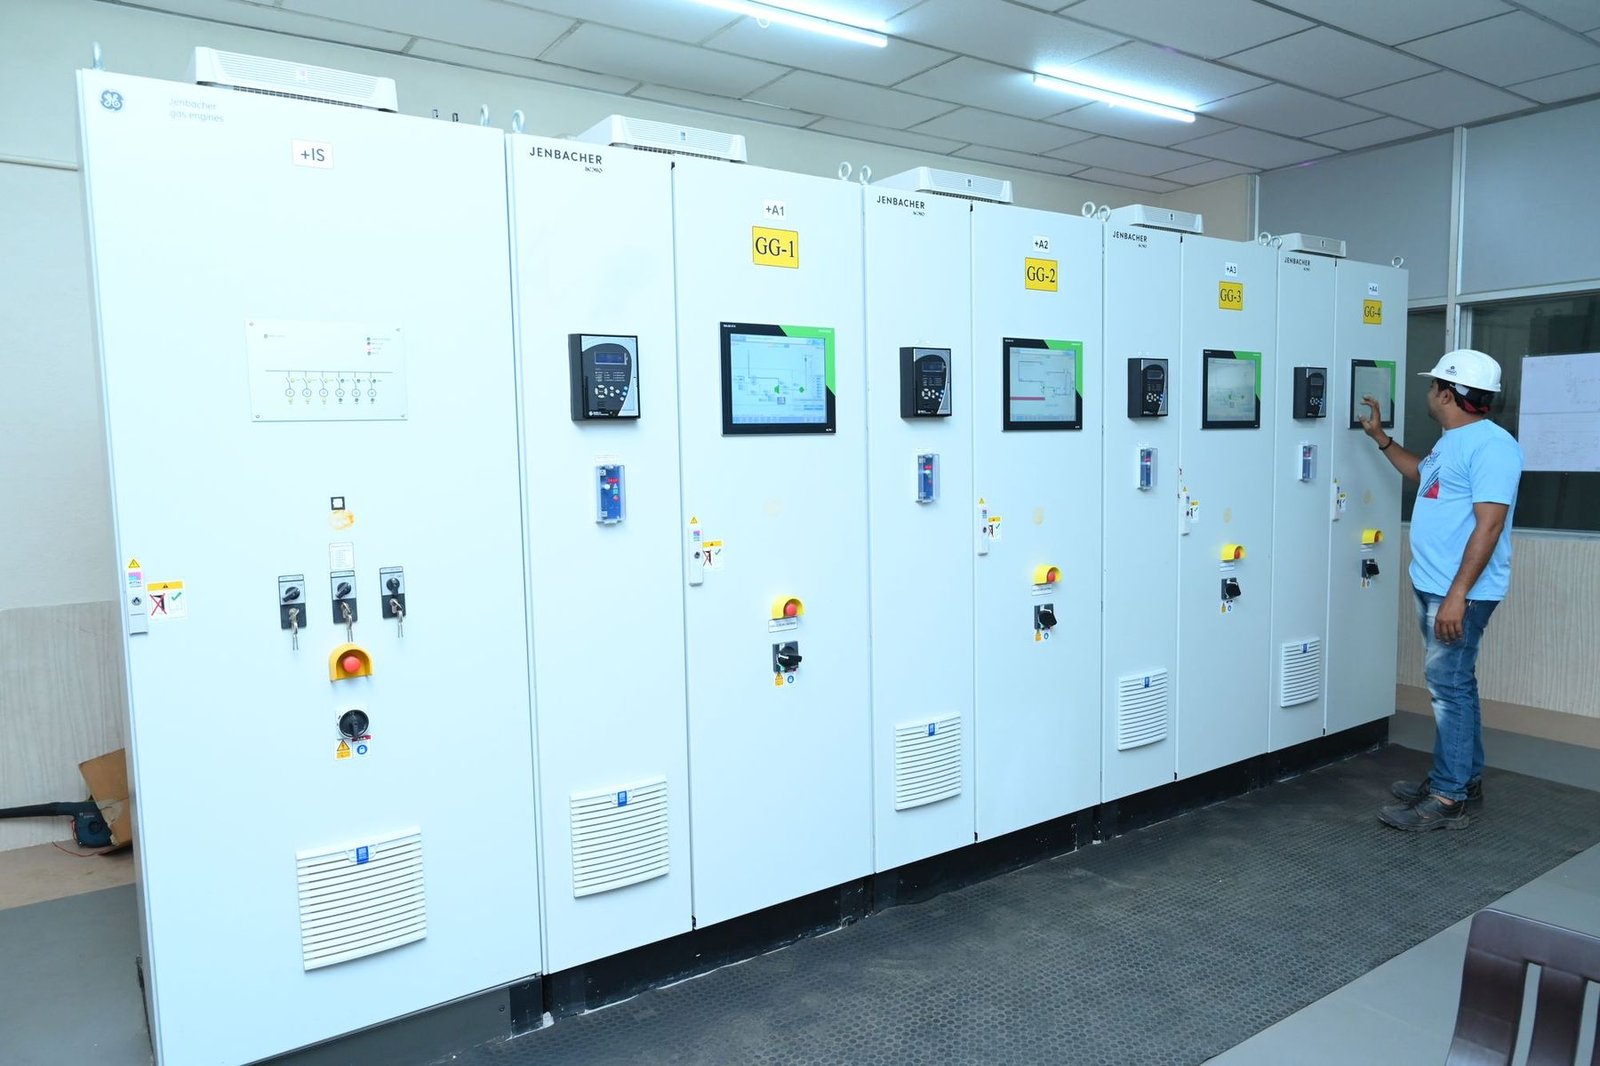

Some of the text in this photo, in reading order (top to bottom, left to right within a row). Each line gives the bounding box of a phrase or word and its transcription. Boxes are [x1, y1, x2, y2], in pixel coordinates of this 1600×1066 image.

[170, 98, 216, 110] Jenbacher
[170, 110, 224, 123] gas engines
[301, 148, 325, 162] +IS
[530, 147, 602, 165] JENBACHER
[877, 195, 925, 210] JENBACHER
[766, 205, 784, 216] +A1
[1112, 231, 1148, 243] JENBACHER
[755, 236, 795, 258] GG-1
[1035, 240, 1049, 249] +A2
[1027, 266, 1055, 283] GG-2
[1226, 266, 1237, 274] +A3
[1220, 288, 1241, 303] GG-3
